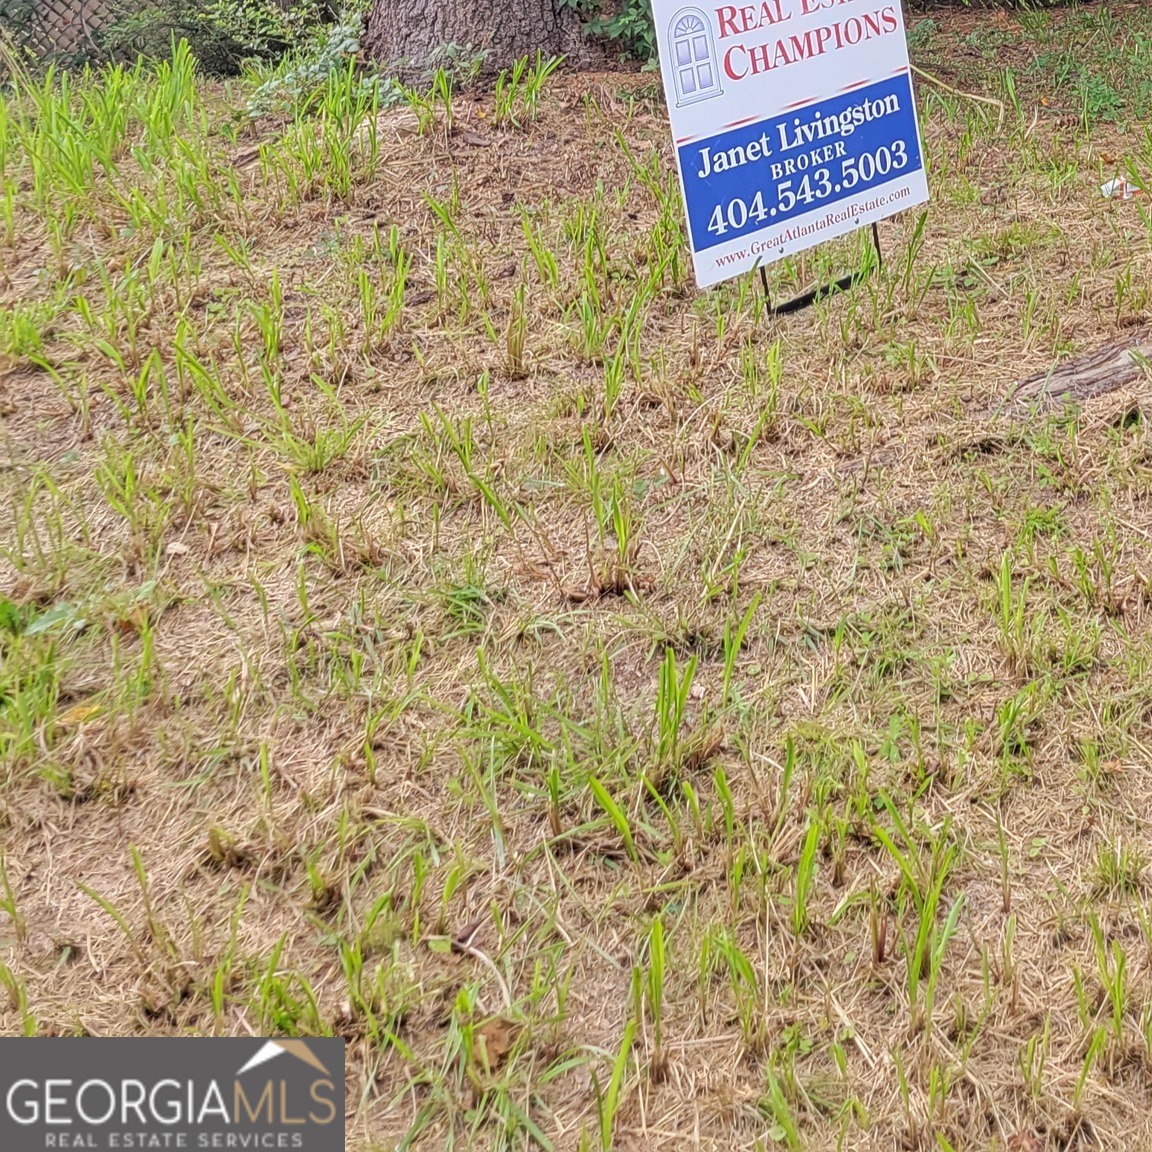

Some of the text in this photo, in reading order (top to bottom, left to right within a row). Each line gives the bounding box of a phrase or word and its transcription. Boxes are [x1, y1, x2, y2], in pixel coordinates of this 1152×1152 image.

[723, 7, 899, 81] CHAMPIONS
[697, 93, 900, 179] Janet Livingston
[770, 140, 847, 181] BROKER
[707, 140, 909, 237] 404.543.5003
[715, 185, 911, 269] www.GreatAtlantaRealEstate.com
